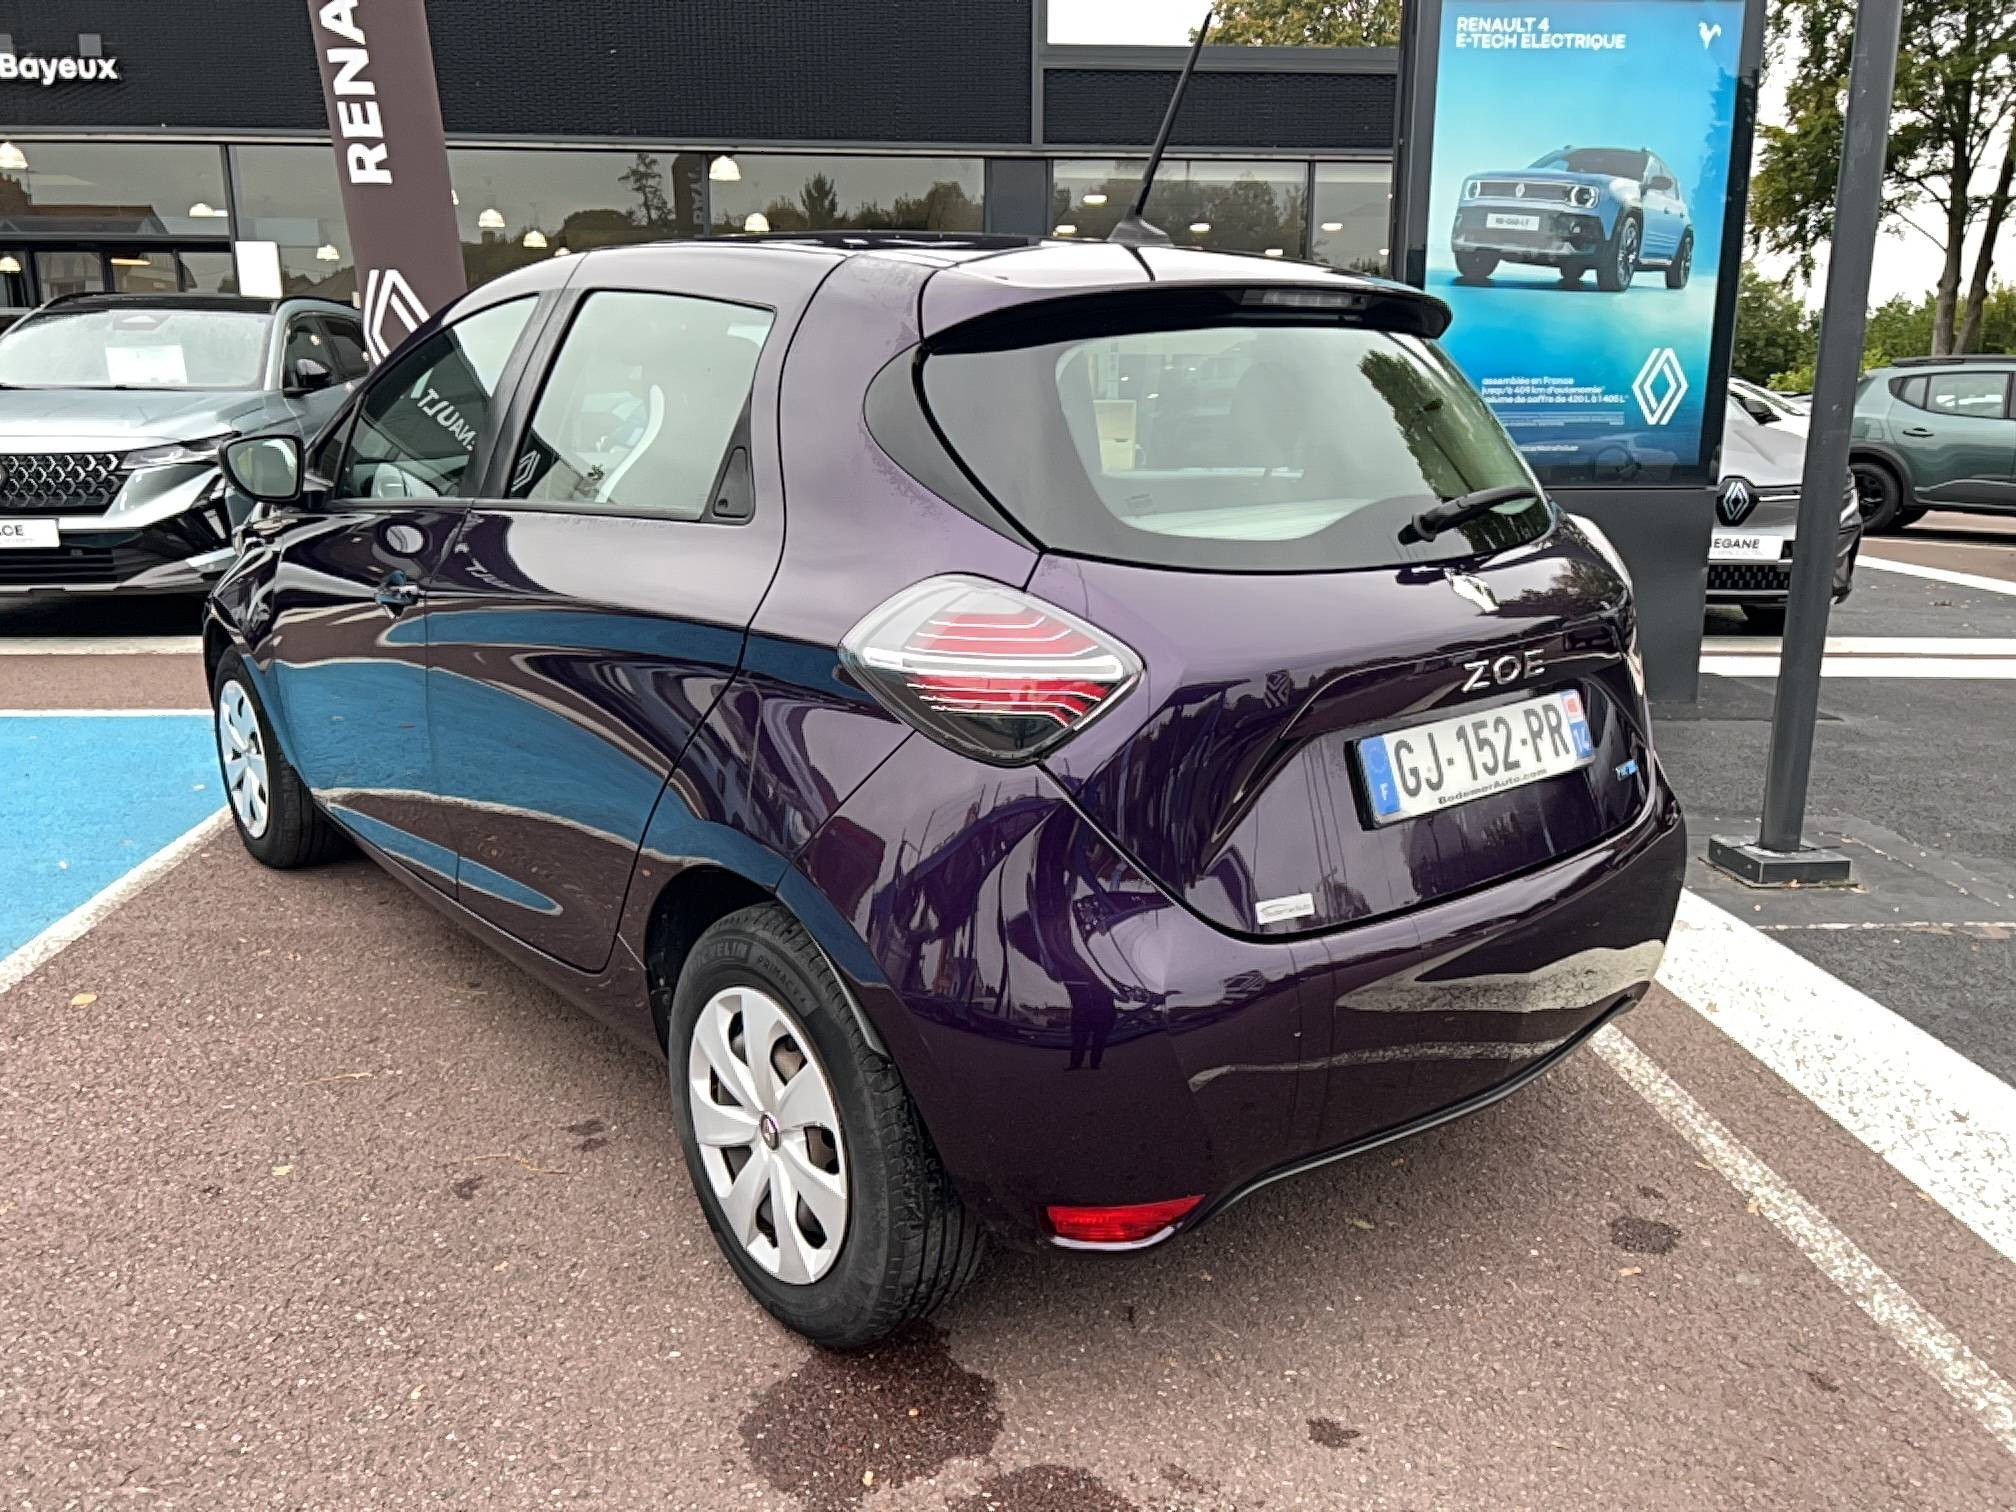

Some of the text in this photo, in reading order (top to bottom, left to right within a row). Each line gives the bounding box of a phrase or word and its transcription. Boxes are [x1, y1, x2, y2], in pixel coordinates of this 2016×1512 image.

[1456, 16, 1550, 33] RENAULT 4
[1455, 33, 1627, 51] E-TECH ELECTRIQUE
[0, 53, 119, 85] Bayeux
[318, 0, 393, 184] RENA
[0, 524, 24, 536] CE
[1713, 538, 1760, 549] EGANE
[1461, 648, 1546, 693] ZOE
[1394, 703, 1571, 798] GJ-152-PR
[1379, 782, 1389, 801] F
[694, 942, 750, 967] ICHELIN
